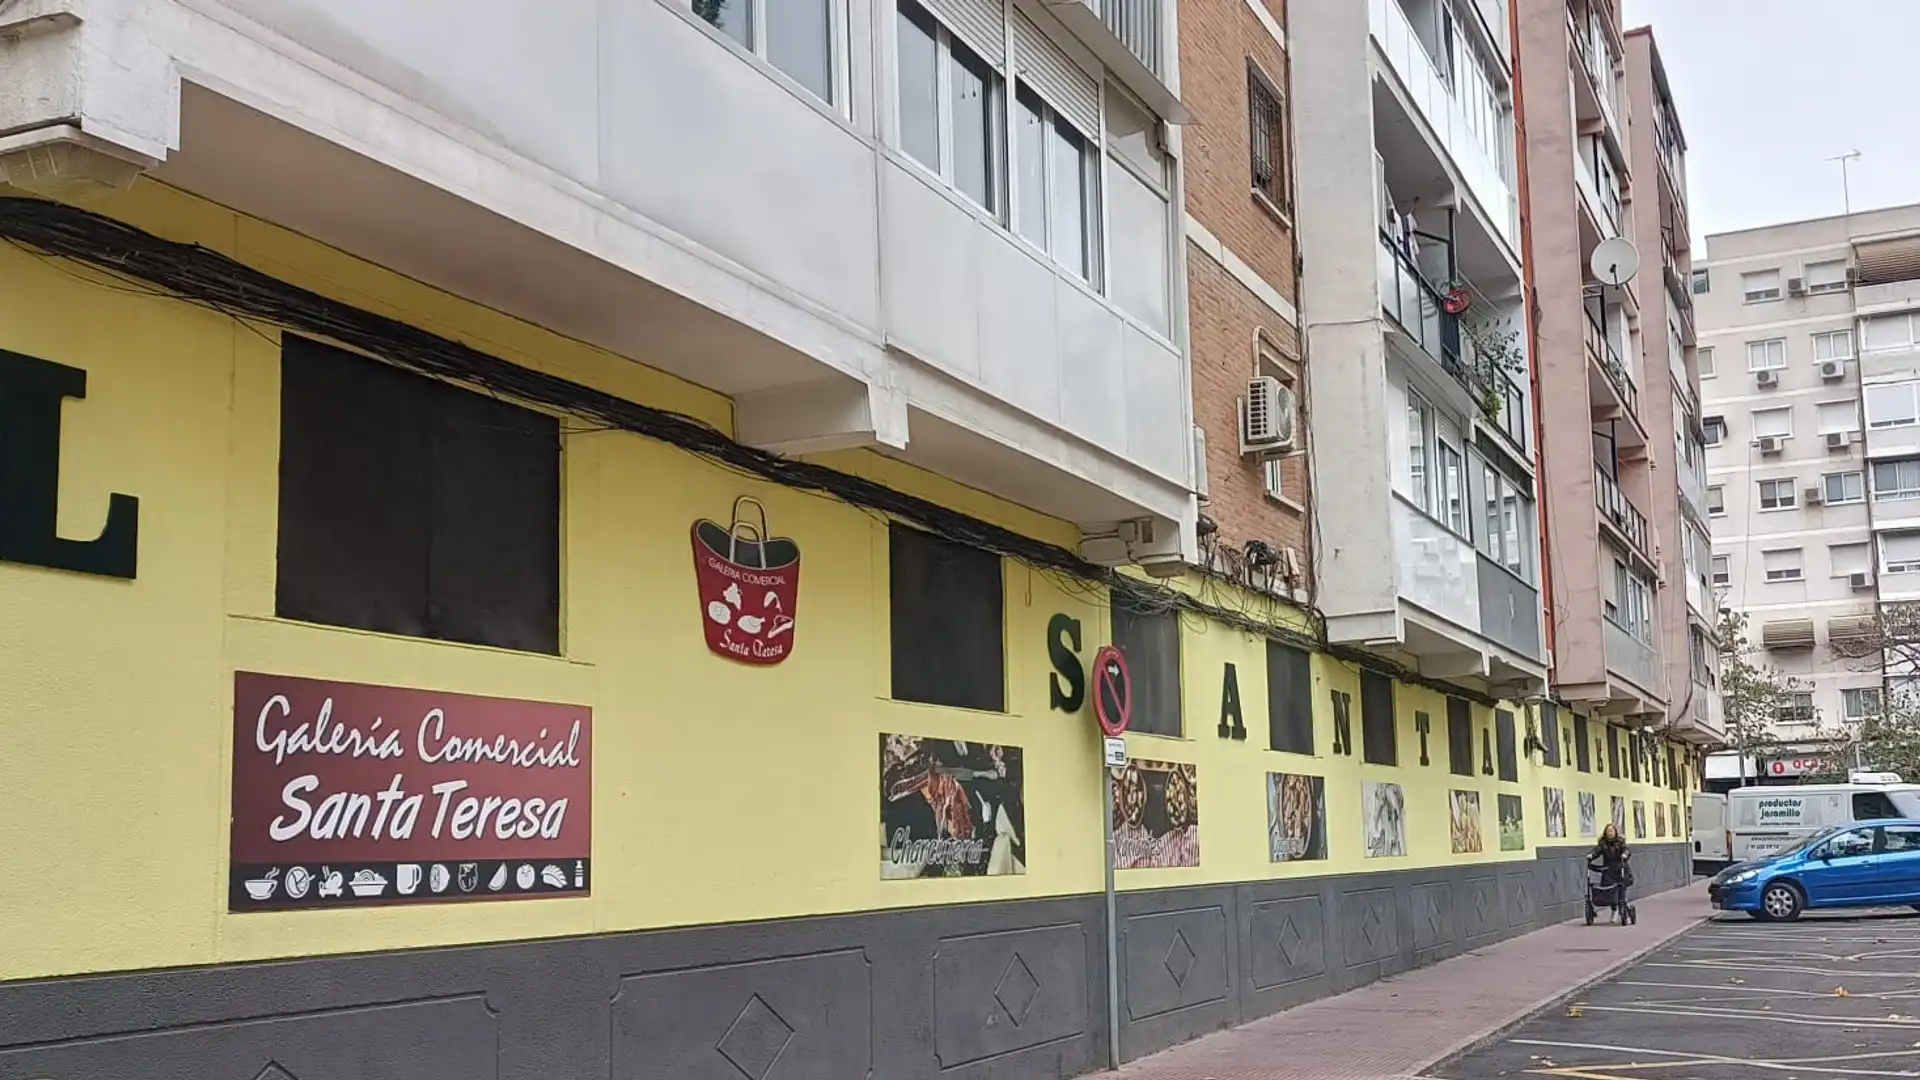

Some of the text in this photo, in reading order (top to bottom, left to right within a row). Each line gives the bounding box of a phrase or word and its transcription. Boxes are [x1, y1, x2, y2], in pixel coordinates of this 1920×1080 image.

[742, 572, 786, 586] COMERCIAL
[719, 629, 783, 658] Santa Teresa
[254, 694, 581, 768] Galería Comercial
[269, 774, 568, 841] Santa Teresa
[1759, 798, 1802, 809] productos
[1760, 808, 1801, 819] jaramillo
